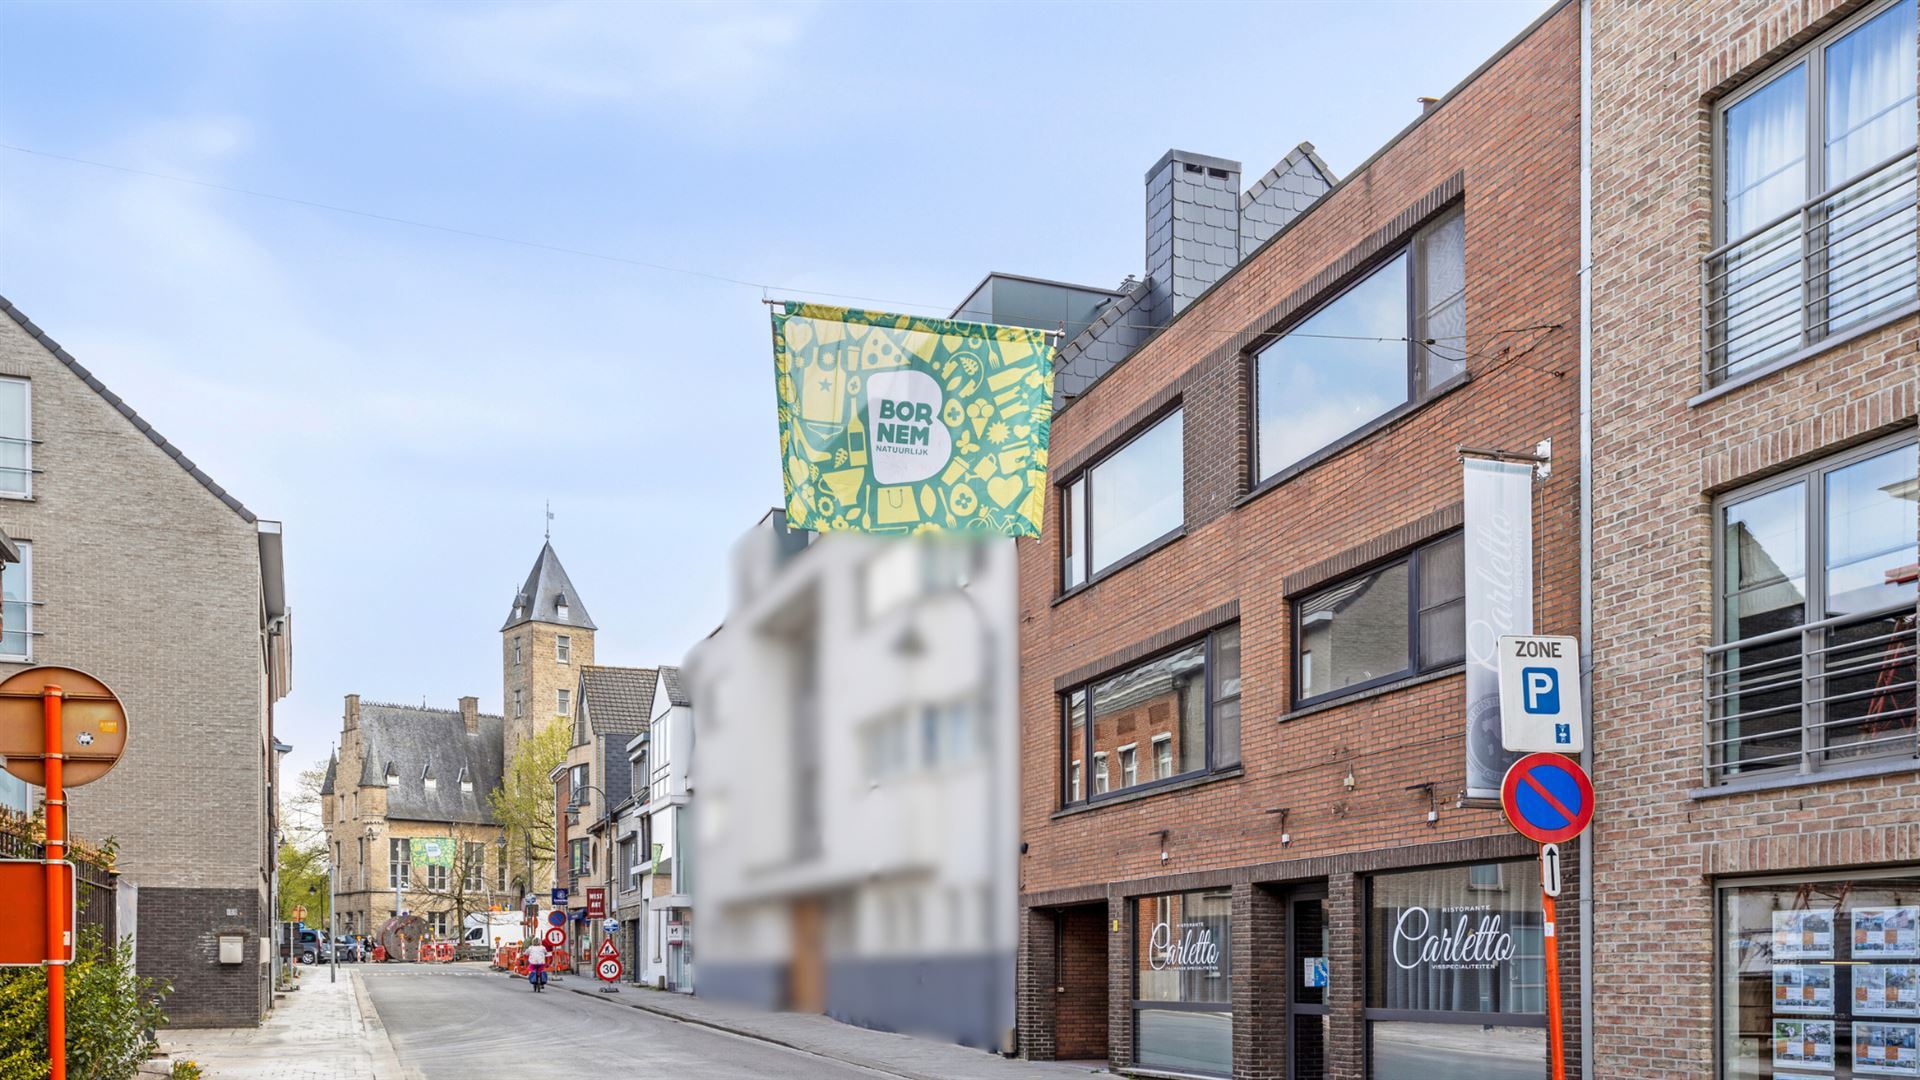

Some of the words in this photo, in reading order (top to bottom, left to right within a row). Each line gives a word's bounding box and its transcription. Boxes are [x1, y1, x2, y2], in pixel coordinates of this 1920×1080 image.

[880, 399, 933, 425] BOR
[877, 423, 930, 446] NEM
[876, 445, 928, 456] NATUURLIJK
[1515, 641, 1562, 658] ZONE
[1527, 672, 1554, 709] P
[1442, 905, 1491, 913] RISTORANTE
[1149, 922, 1219, 970] Carletto
[1393, 905, 1516, 969] Carletto
[602, 964, 617, 974] 30
